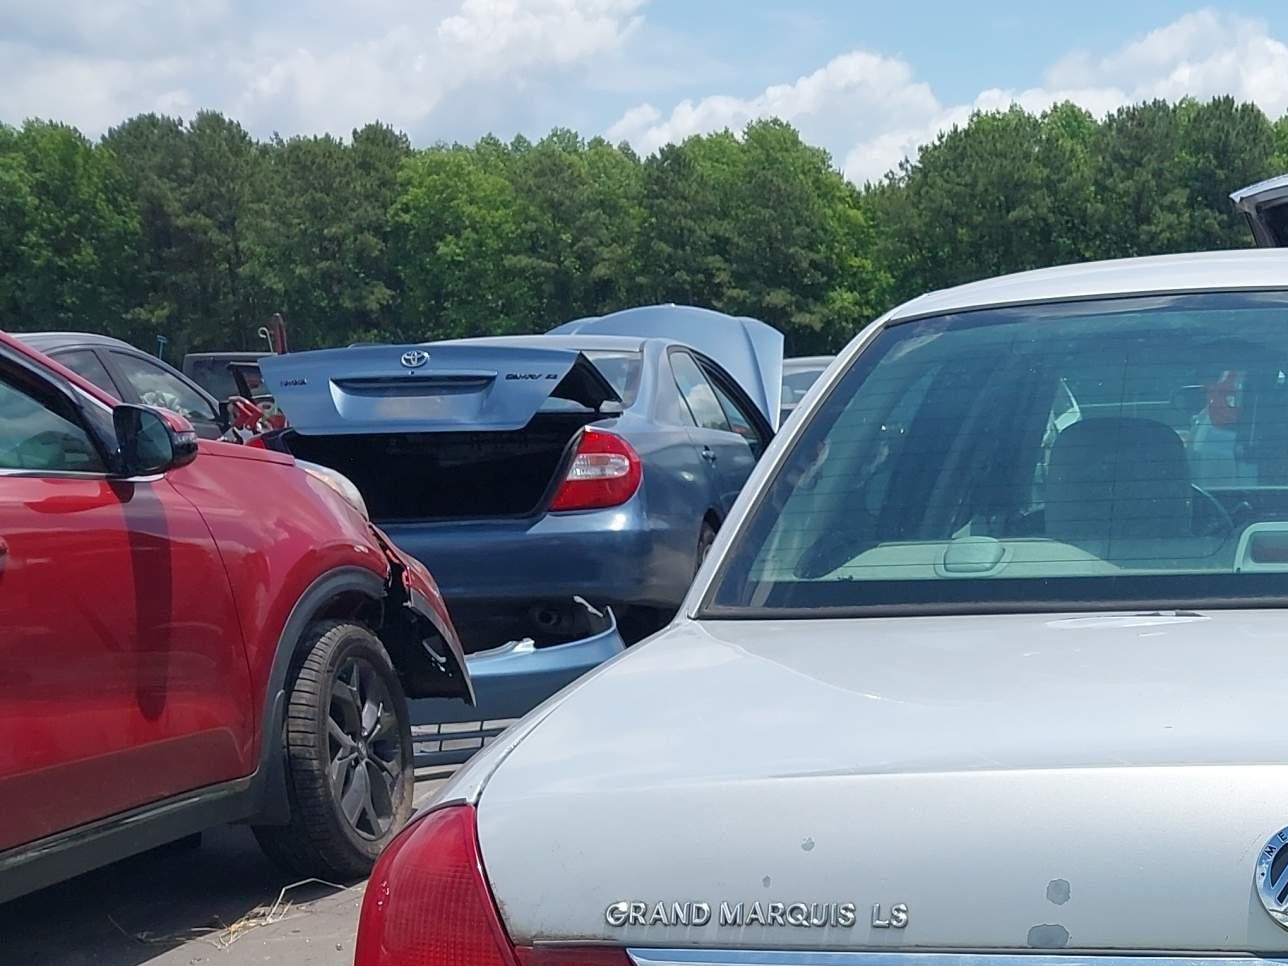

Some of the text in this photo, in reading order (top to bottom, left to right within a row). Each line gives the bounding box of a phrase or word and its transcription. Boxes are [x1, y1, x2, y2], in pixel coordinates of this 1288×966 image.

[605, 901, 908, 929] GRAND MARQUIS LS
